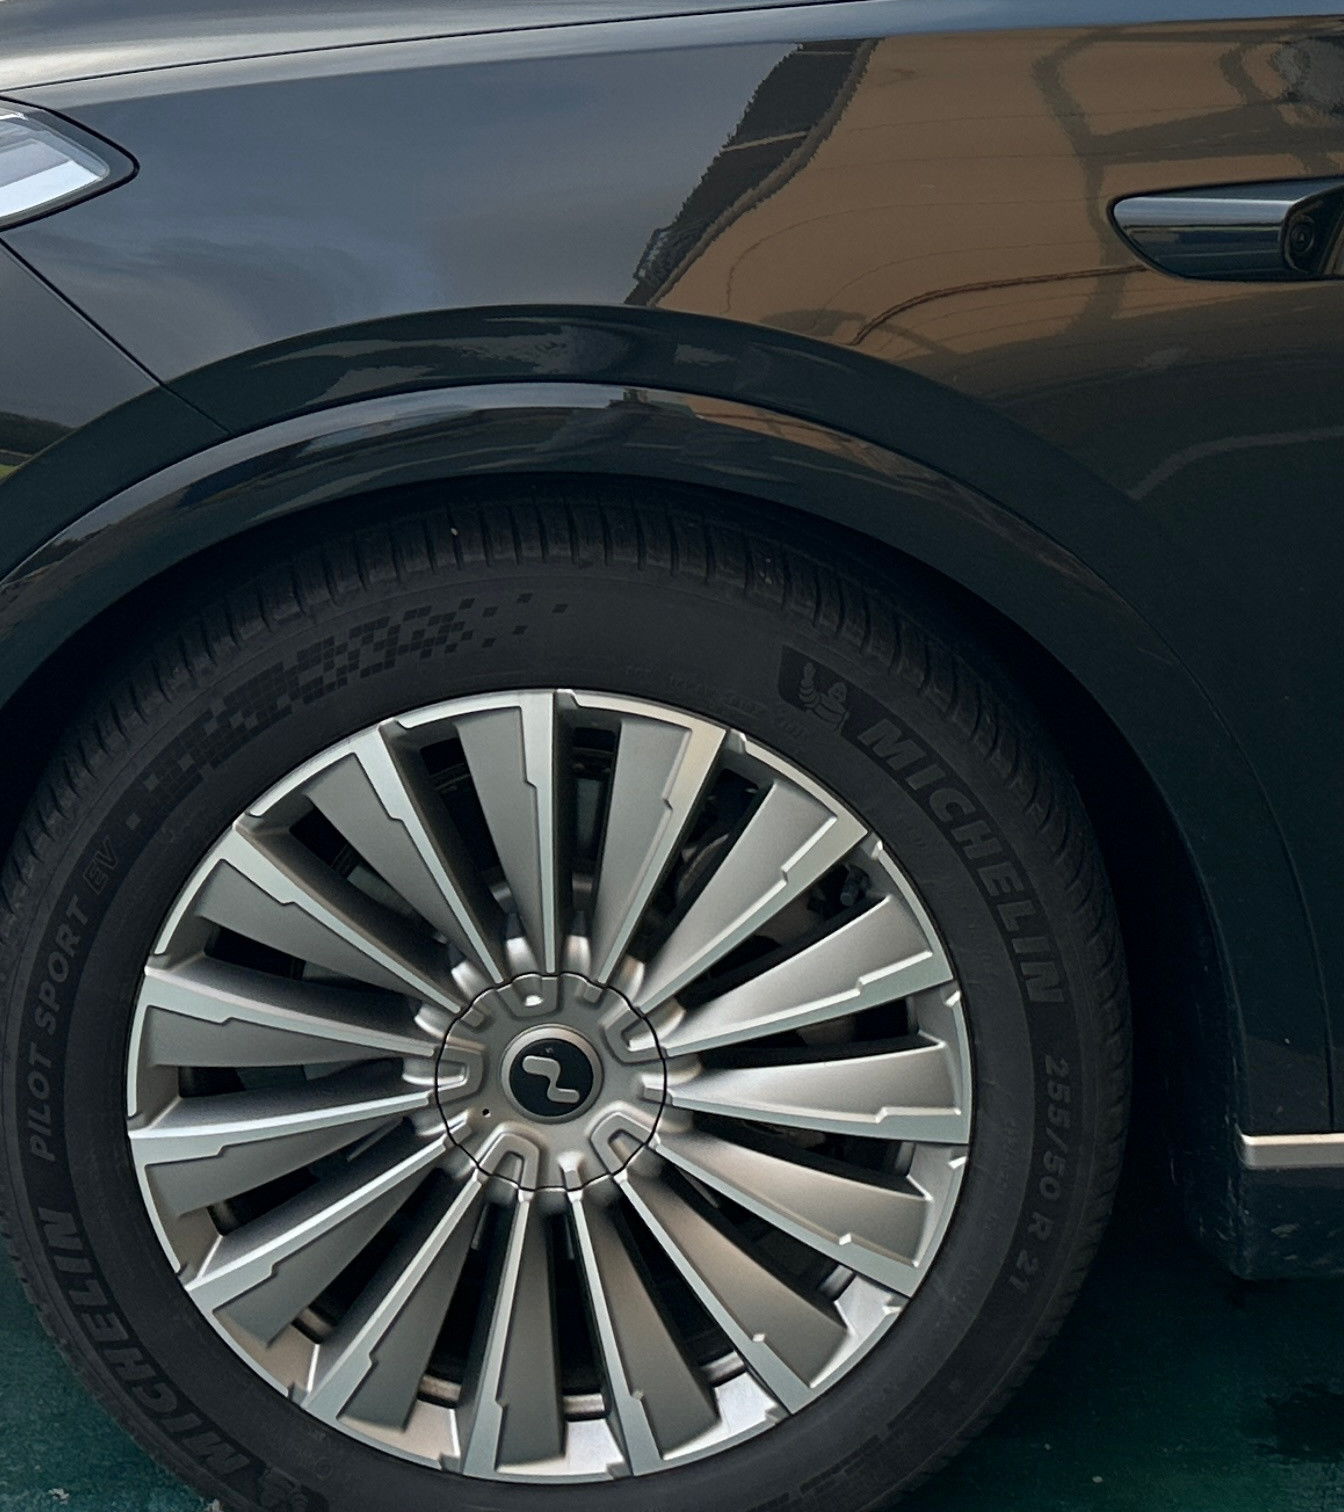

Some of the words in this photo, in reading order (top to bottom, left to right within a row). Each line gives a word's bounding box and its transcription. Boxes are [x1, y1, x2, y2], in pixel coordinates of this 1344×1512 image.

[856, 718, 1065, 1003] MICHELIN
[34, 893, 90, 1037] SPORT
[27, 1041, 57, 1163] PILOT
[36, 1205, 253, 1476] MICHELIN
